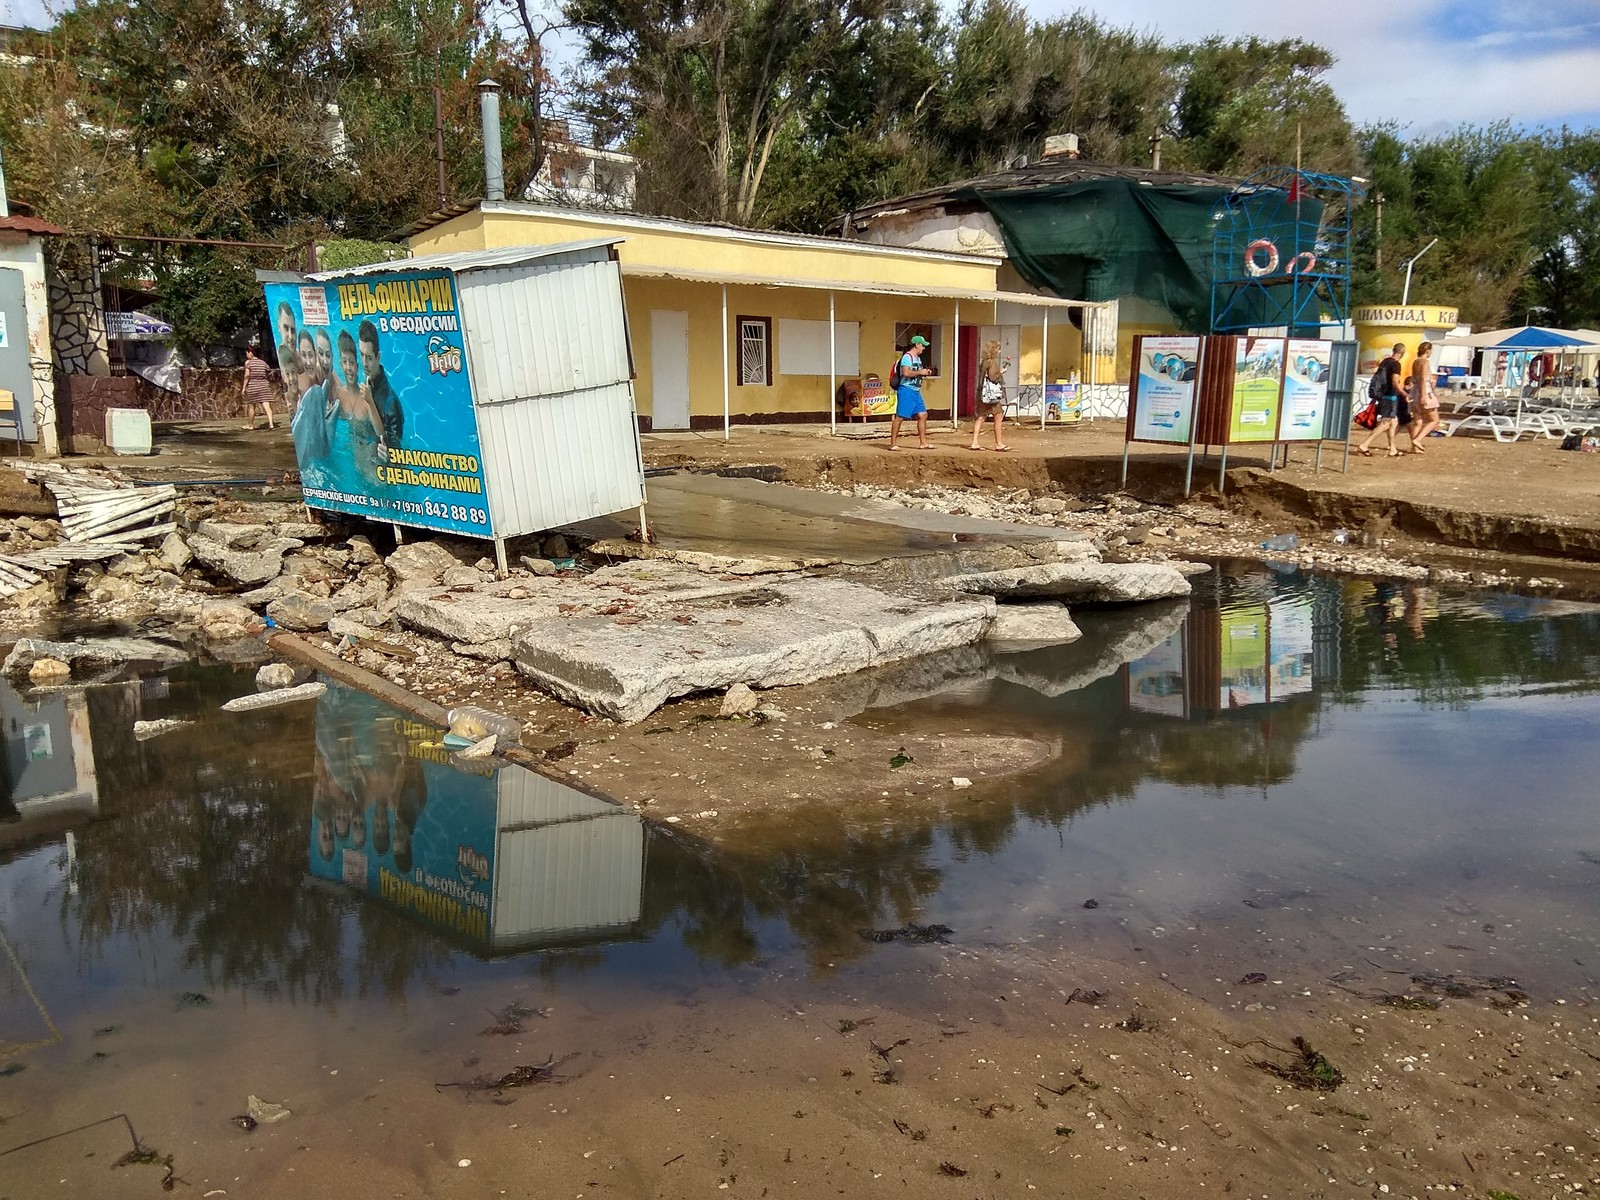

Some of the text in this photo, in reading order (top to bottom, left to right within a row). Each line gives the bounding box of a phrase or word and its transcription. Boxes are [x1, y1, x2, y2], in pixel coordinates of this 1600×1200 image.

[380, 315, 458, 334] В ФЕОДОСИИ
[388, 448, 479, 473] ЗНАКОМСТВО
[376, 465, 482, 494] С ДЕЛЬФИНАМИ
[343, 492, 368, 506] ШОССЕ
[392, 500, 401, 512] +7
[402, 501, 424, 516] (978)
[425, 499, 449, 519] 842
[451, 504, 468, 522] 88
[469, 507, 487, 525] 89
